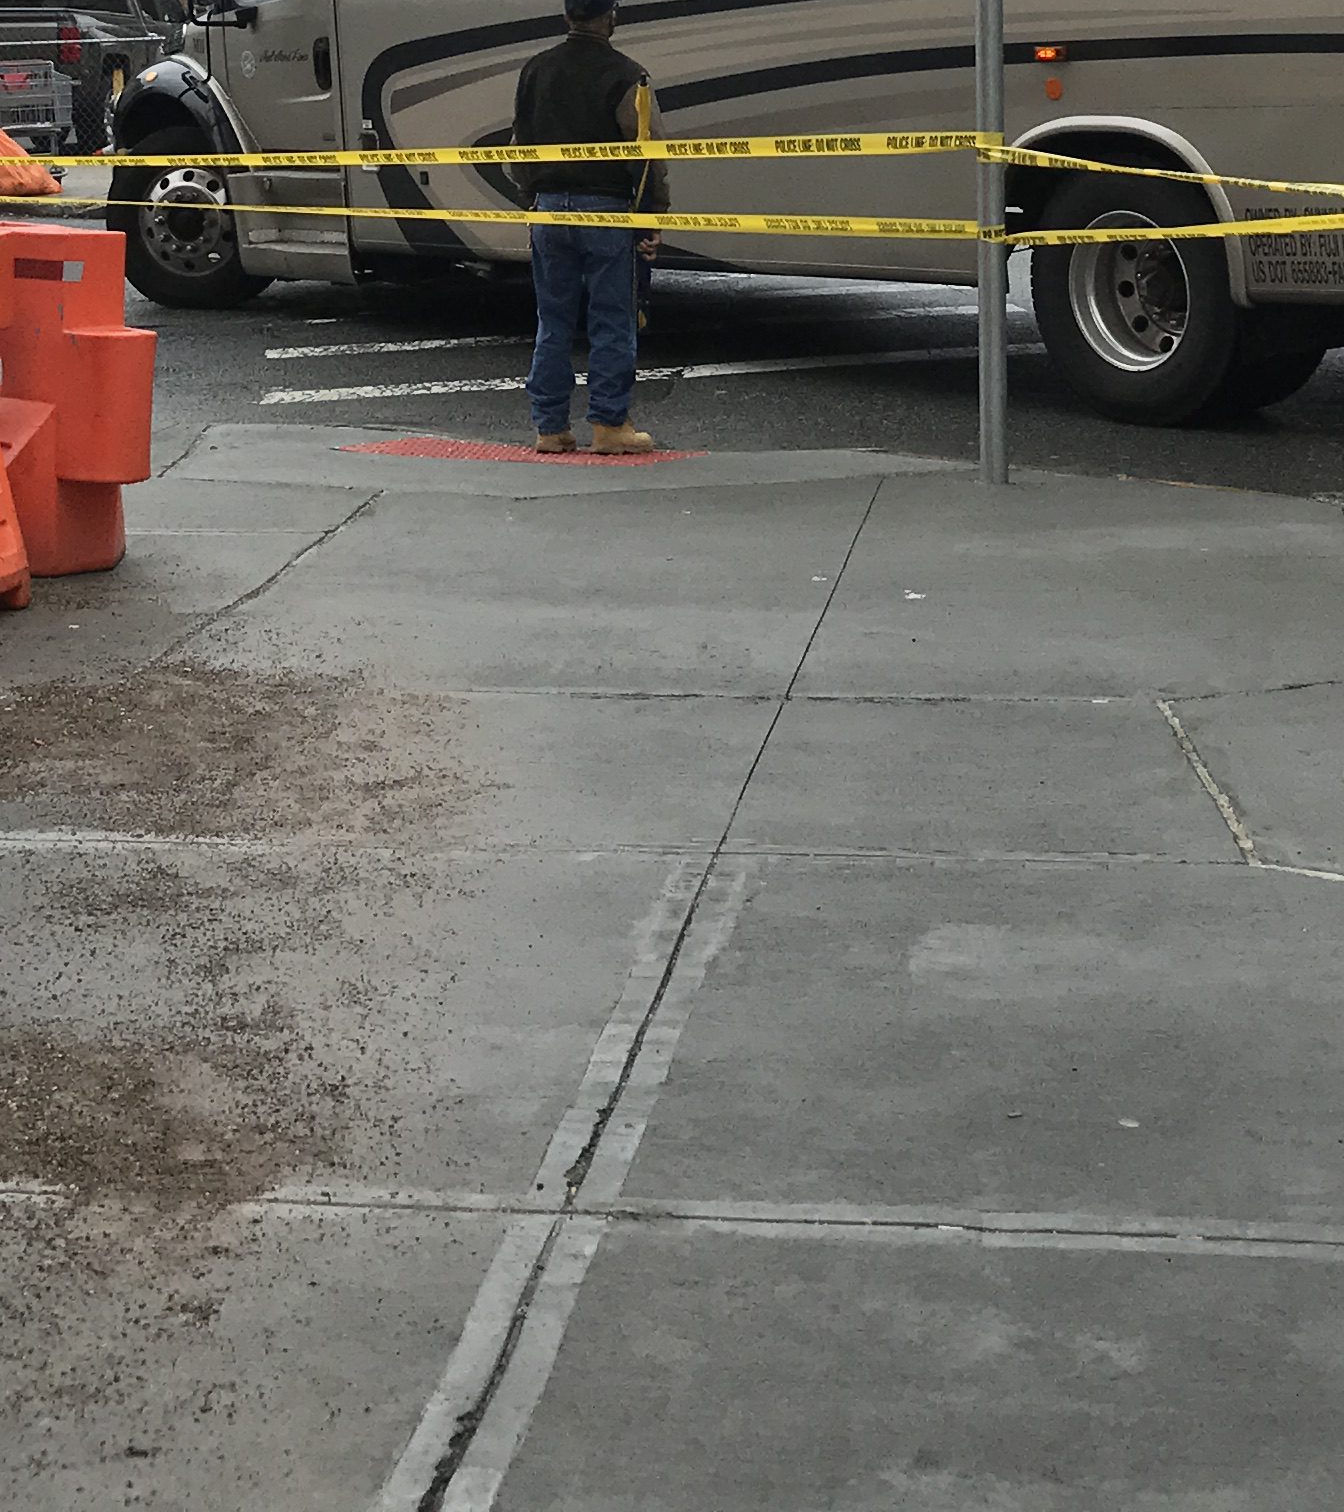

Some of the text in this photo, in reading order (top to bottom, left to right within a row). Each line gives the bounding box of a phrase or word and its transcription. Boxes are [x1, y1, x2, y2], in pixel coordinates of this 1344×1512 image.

[666, 143, 689, 156] POLICE
[705, 142, 716, 155] DO
[716, 142, 728, 154] NOT
[729, 141, 751, 154] CROSS
[774, 140, 798, 153] POLICE
[815, 139, 825, 152] DO
[826, 138, 838, 152] NOT
[839, 138, 861, 151] CROSS
[887, 136, 909, 149] POLICE
[929, 136, 938, 148] DO
[940, 135, 953, 148] NOT
[955, 135, 976, 147] CROSS
[1249, 234, 1297, 256] OPERATED
[1252, 260, 1266, 283] US
[1268, 260, 1287, 283] DOT
